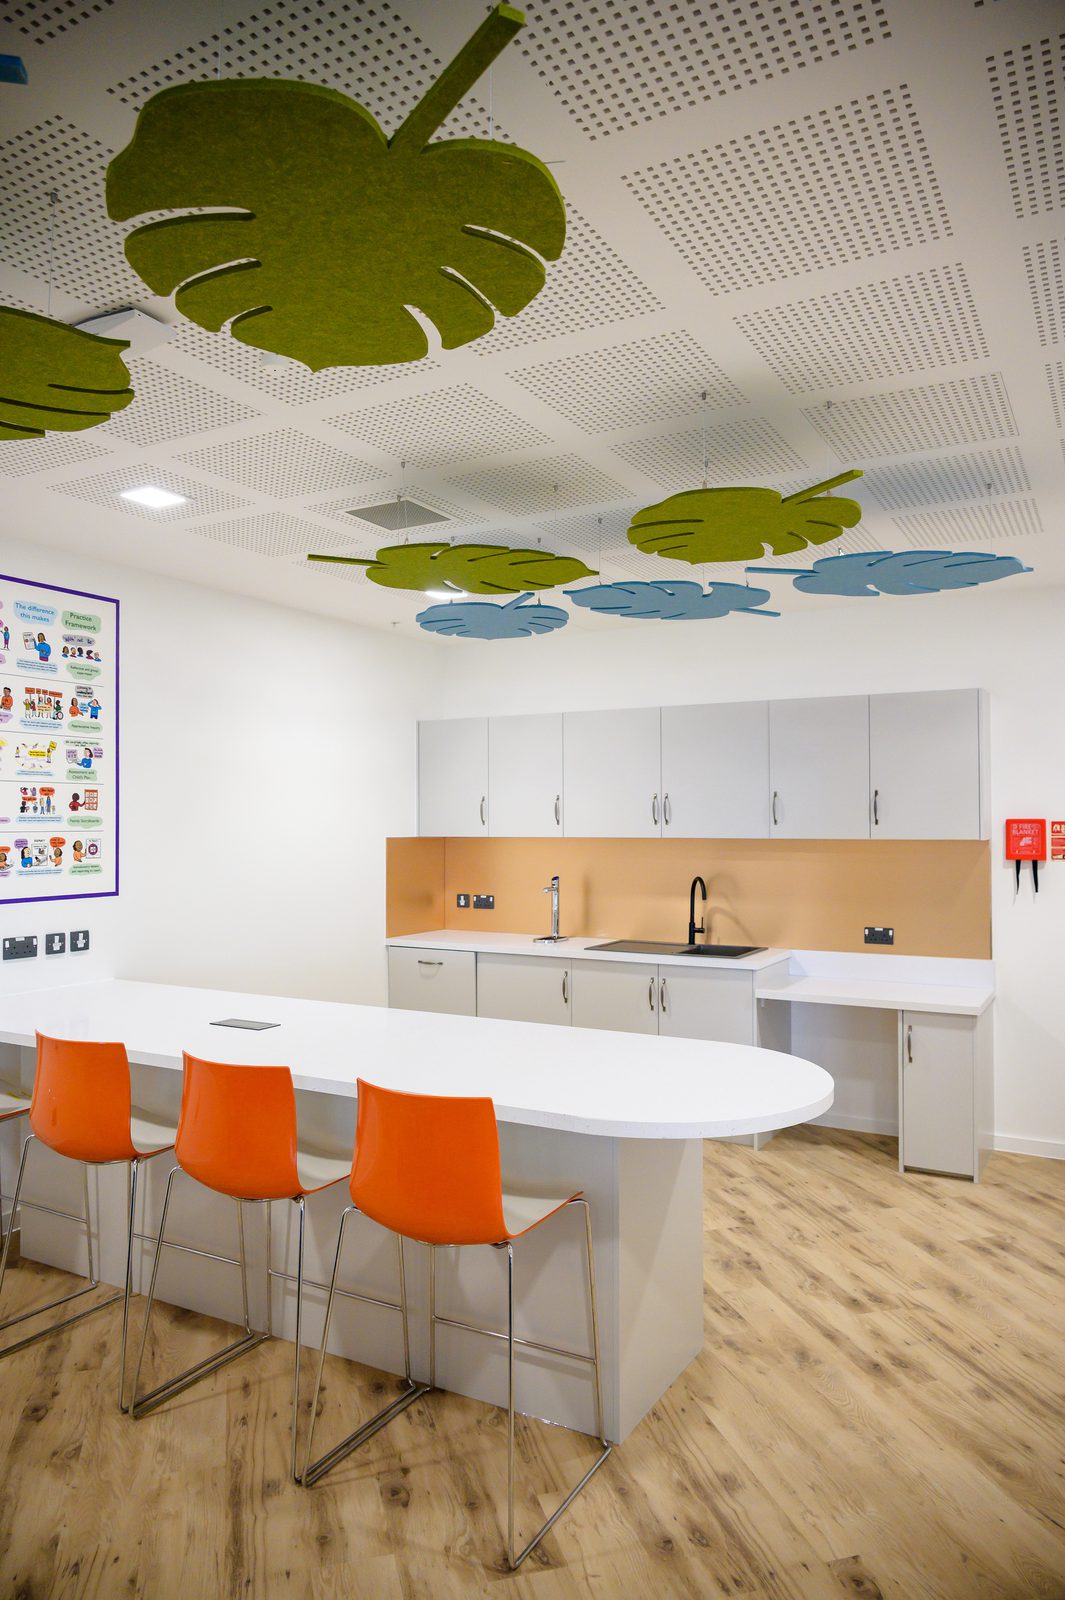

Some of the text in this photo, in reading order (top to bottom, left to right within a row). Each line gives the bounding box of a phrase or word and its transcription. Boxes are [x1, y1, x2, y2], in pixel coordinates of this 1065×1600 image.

[28, 606, 54, 615] difference
[70, 612, 92, 622] Practice
[65, 620, 96, 631] Framework
